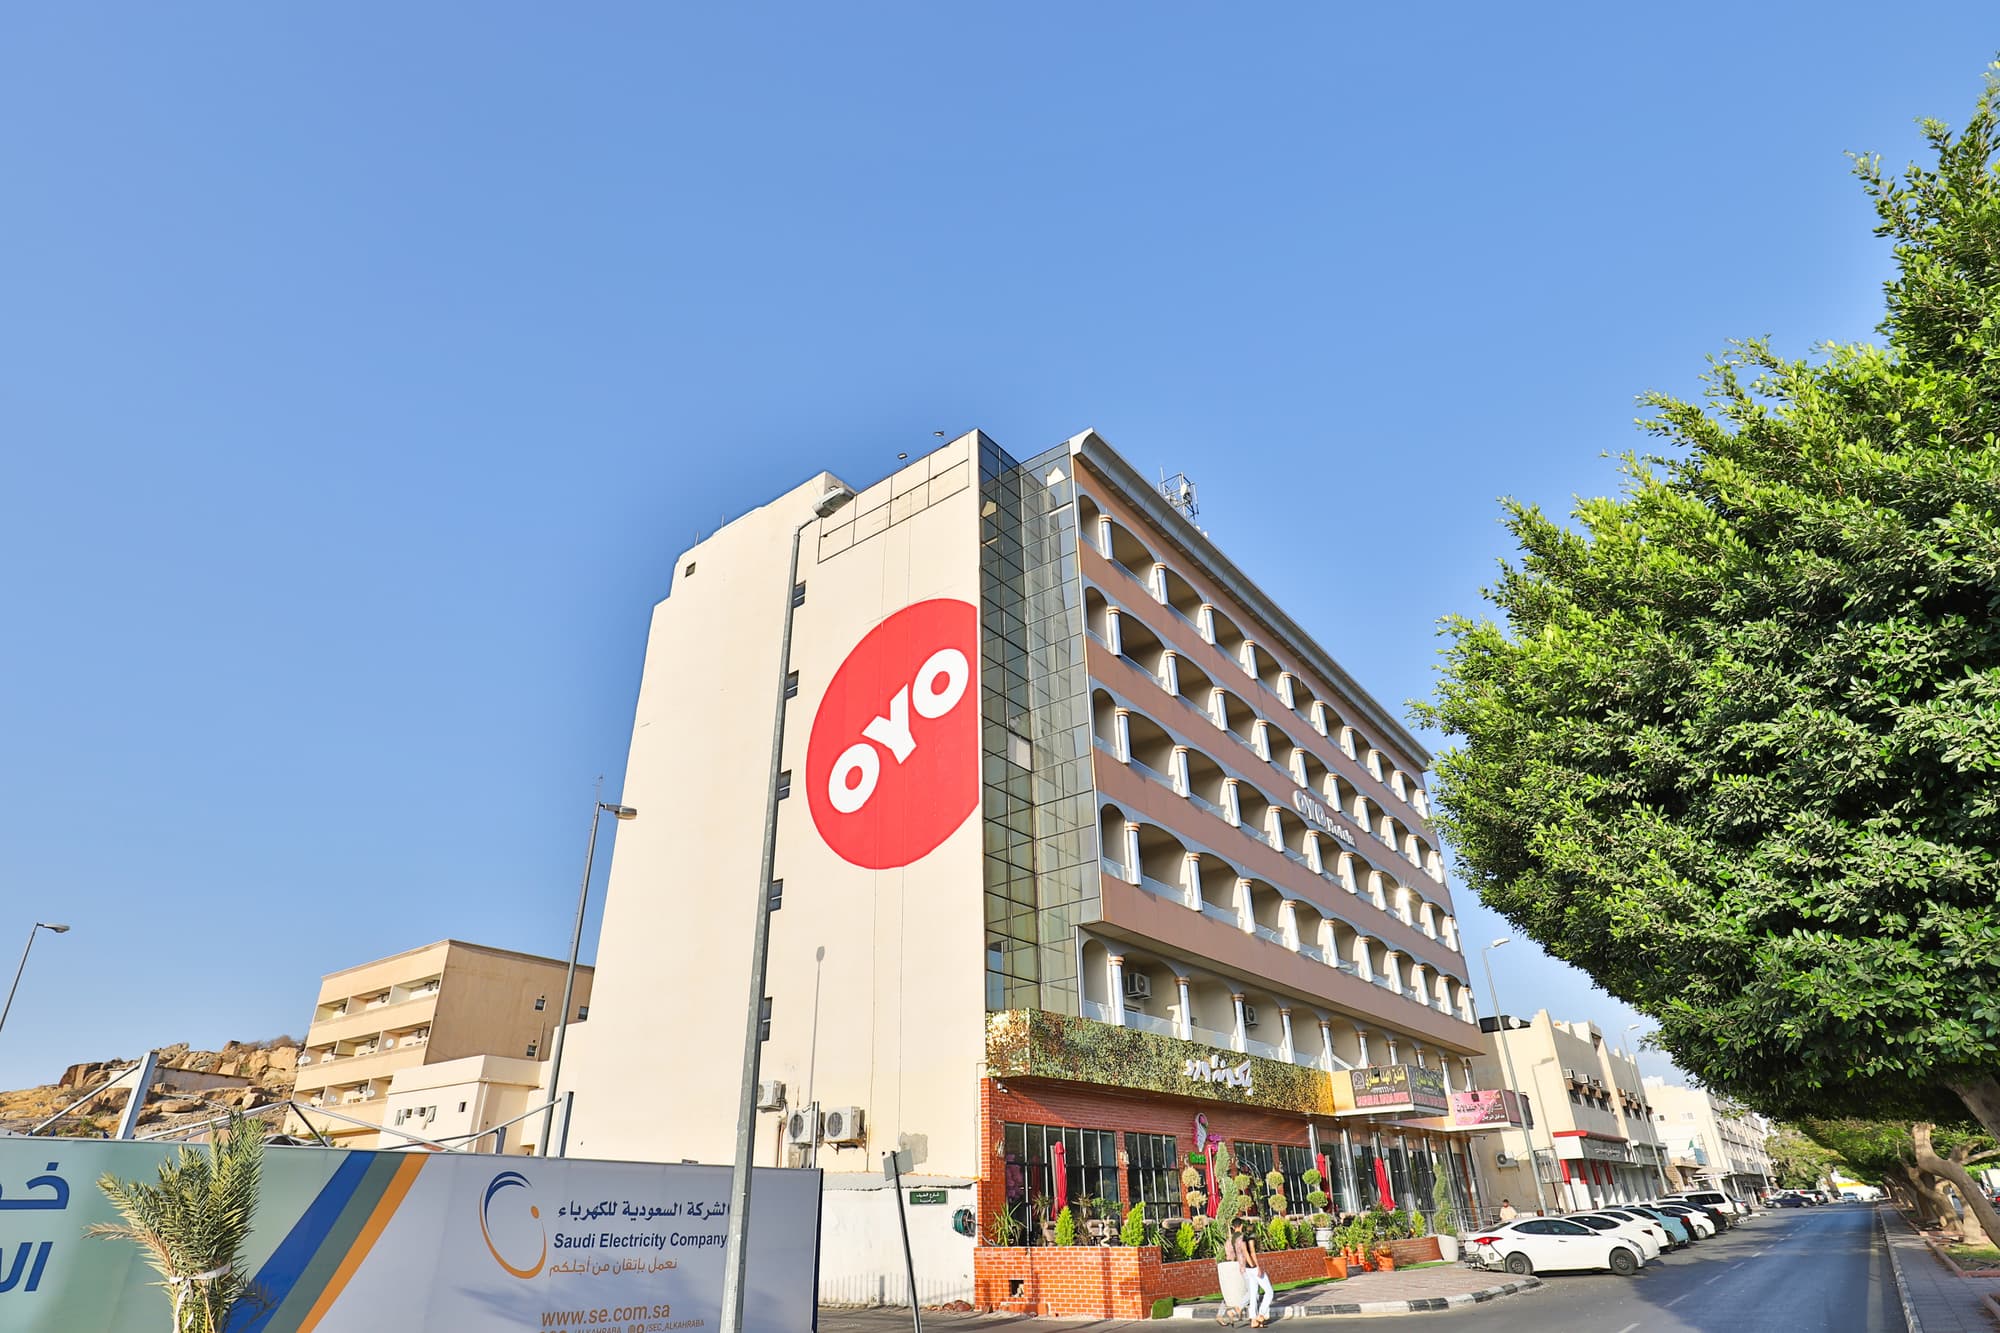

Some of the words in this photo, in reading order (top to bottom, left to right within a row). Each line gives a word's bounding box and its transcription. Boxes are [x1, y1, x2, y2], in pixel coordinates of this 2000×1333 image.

[828, 648, 969, 814] OYO
[1293, 789, 1327, 828] OYO
[0, 1162, 70, 1210] خ
[558, 1200, 617, 1221] للكهرباء
[622, 1200, 682, 1221] السعودية
[687, 1201, 731, 1220] الشركة
[554, 1233, 596, 1248] Saudi
[599, 1232, 667, 1250] Electricity
[670, 1232, 728, 1249] Company
[549, 1256, 591, 1277] أجلكم
[591, 1260, 610, 1275] من
[647, 1257, 678, 1274] نعمل
[541, 1304, 670, 1327] www.se.com.sa
